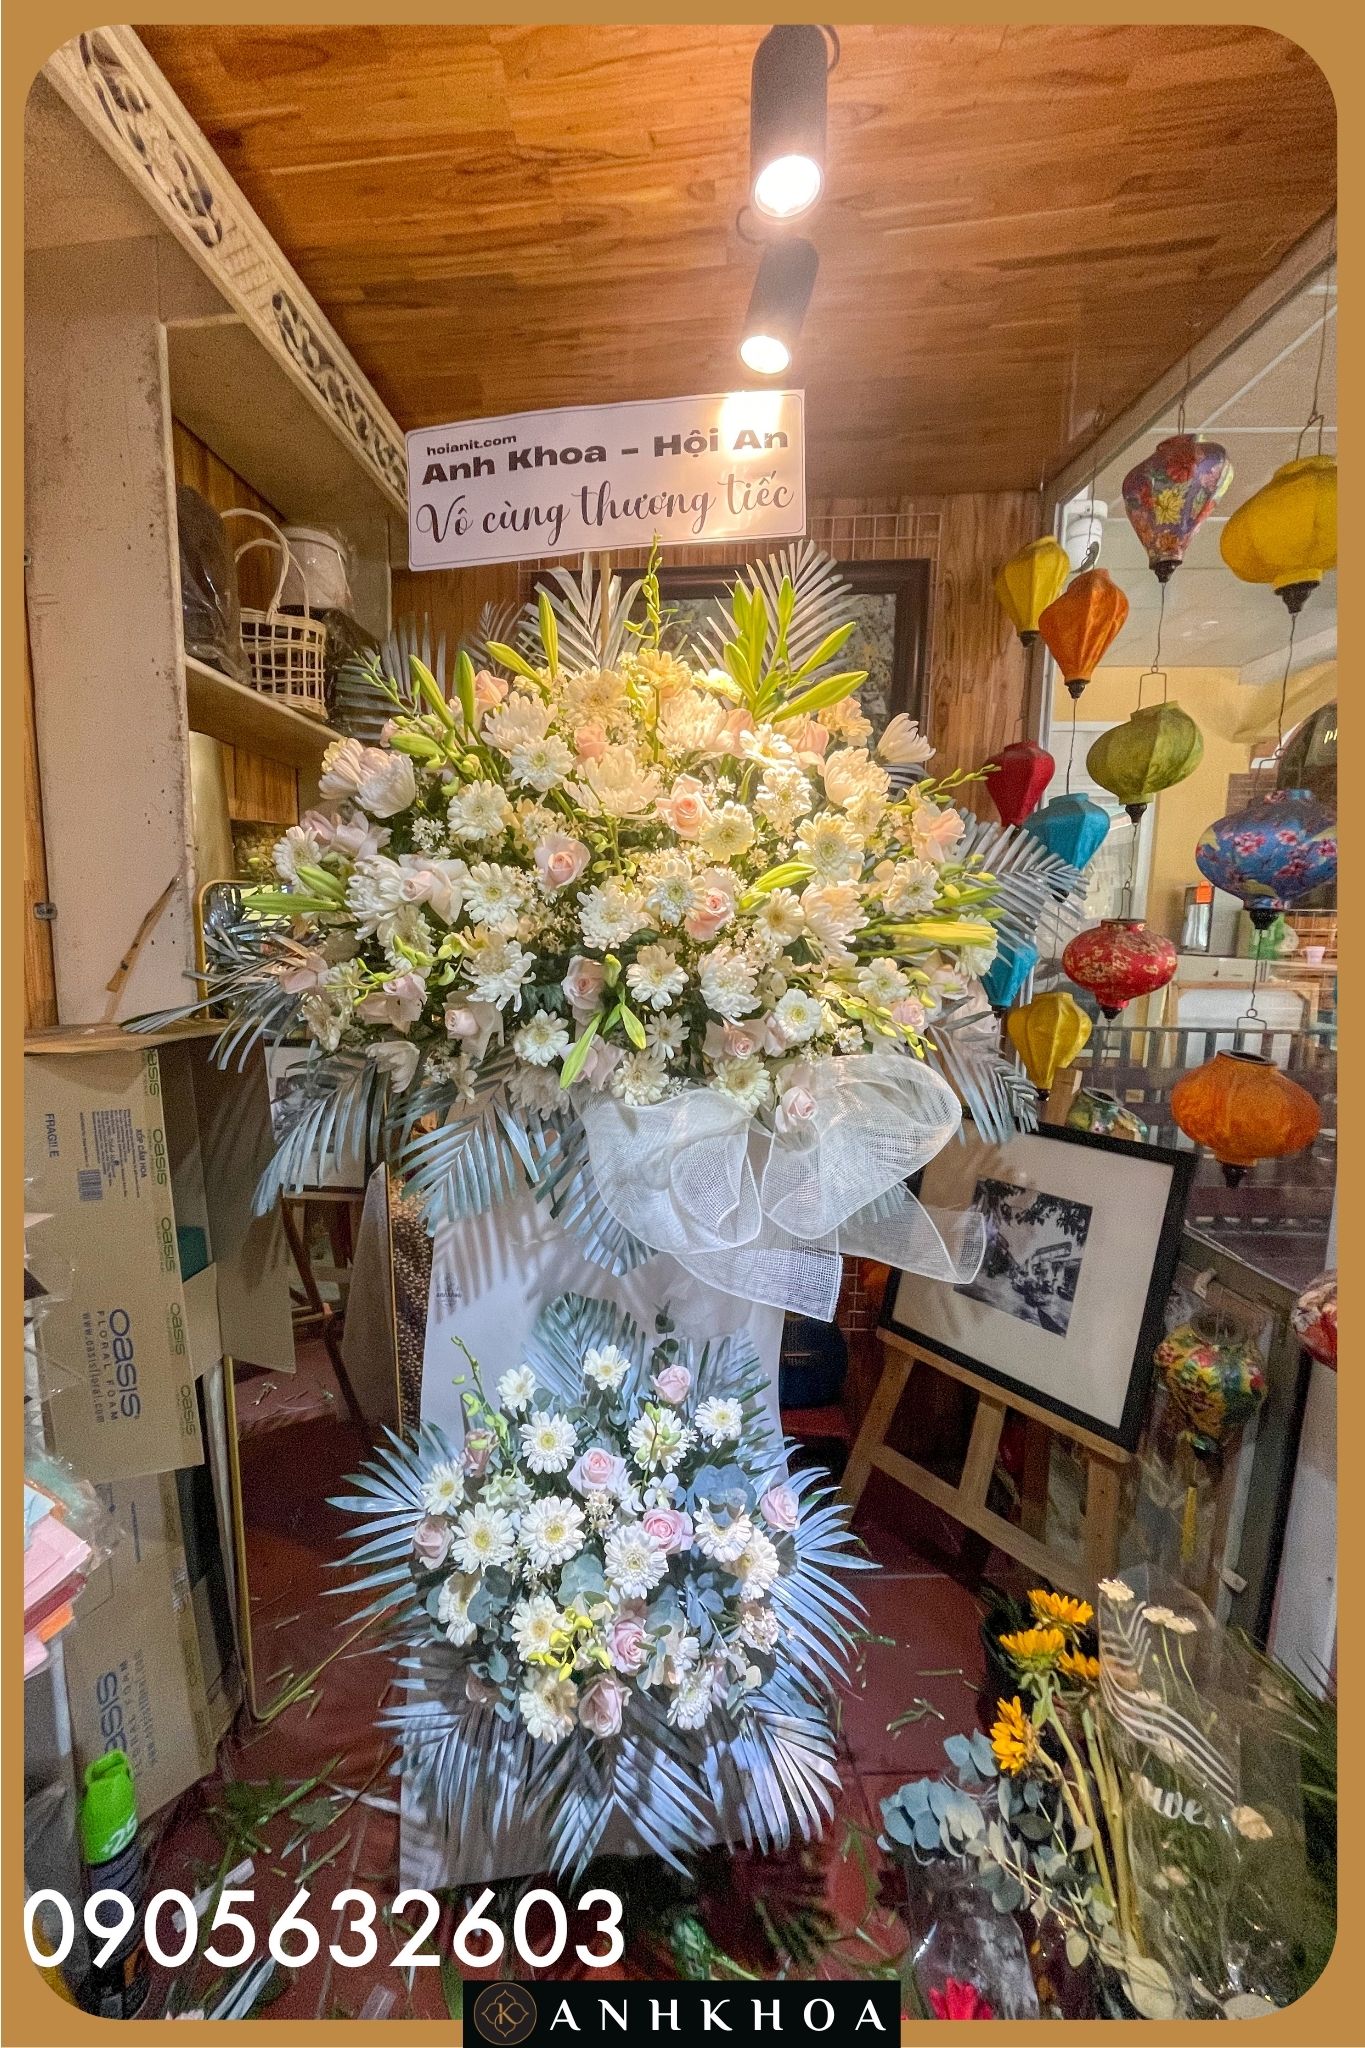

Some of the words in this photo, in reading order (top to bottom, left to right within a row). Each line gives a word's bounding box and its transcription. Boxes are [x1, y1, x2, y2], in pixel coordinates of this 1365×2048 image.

[422, 456, 496, 485] Anh
[508, 443, 607, 471] Khoa
[654, 428, 719, 458] Hội
[733, 428, 788, 450] An
[427, 434, 517, 456] hoianit.com
[415, 495, 473, 543] Vô
[482, 500, 571, 546] cùng
[571, 480, 717, 534] thương
[717, 471, 795, 516] tiếc
[96, 1310, 111, 1370] FLORAL
[106, 1380, 118, 1421] FOAM
